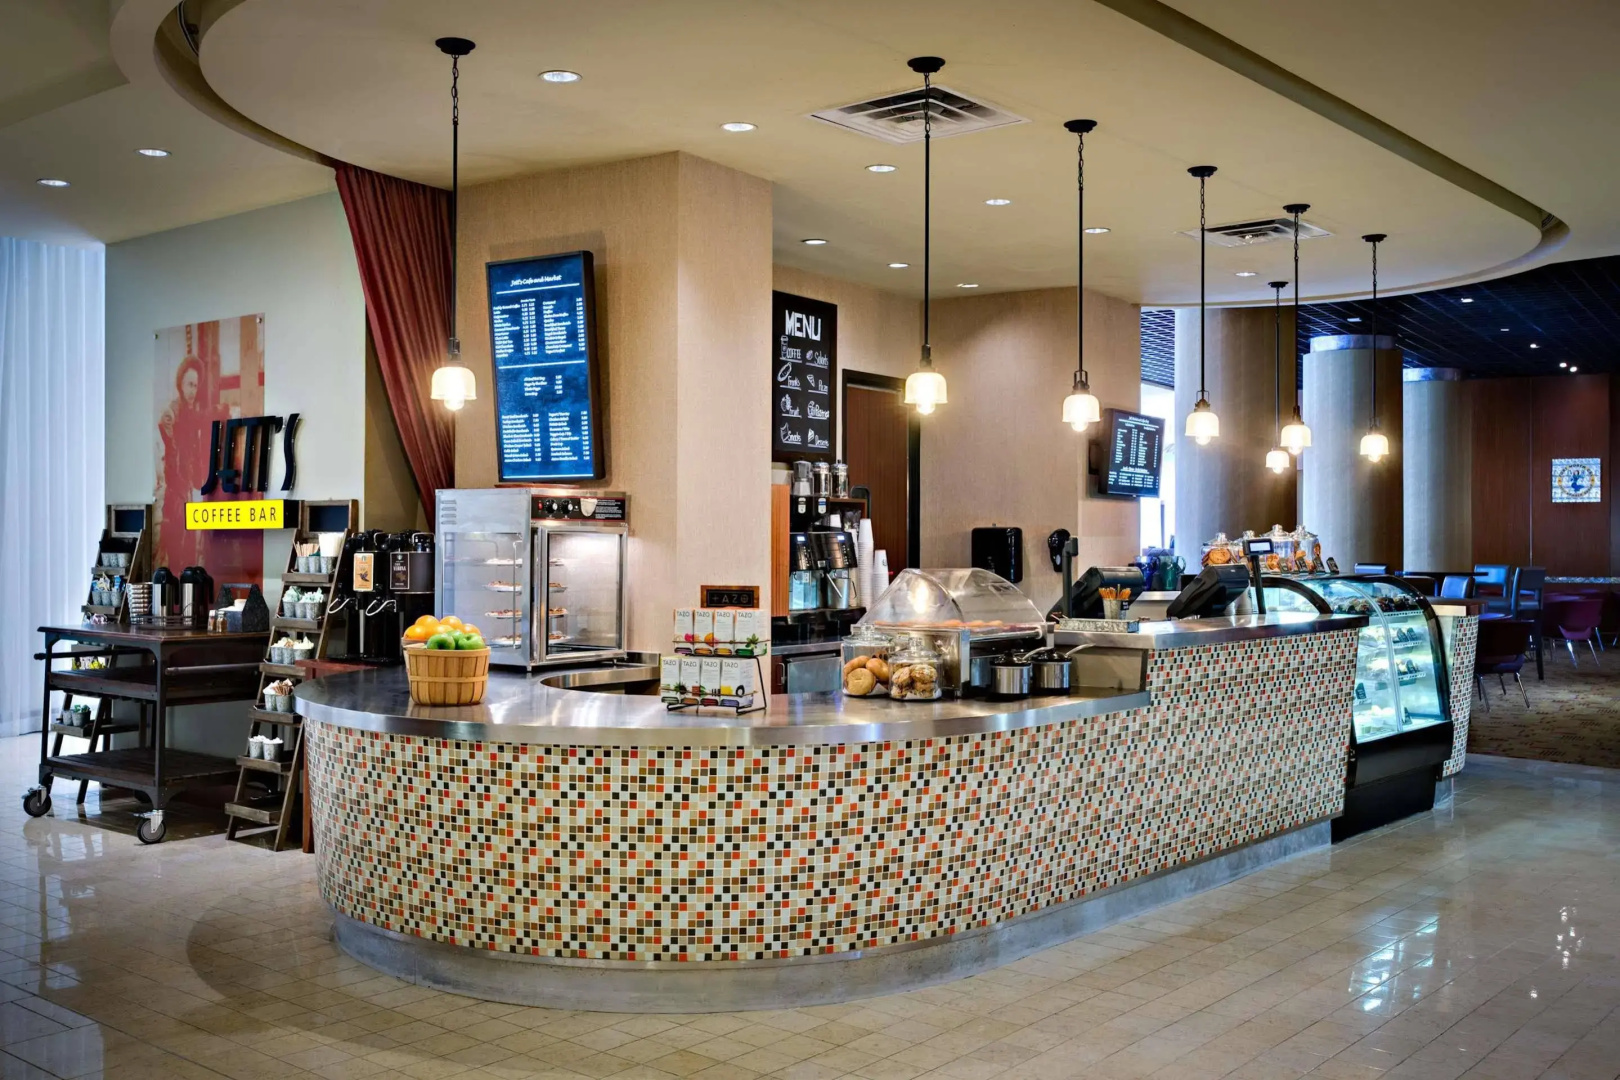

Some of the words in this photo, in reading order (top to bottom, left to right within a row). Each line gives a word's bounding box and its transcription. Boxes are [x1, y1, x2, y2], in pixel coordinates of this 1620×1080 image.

[785, 309, 822, 342] MENU
[193, 508, 241, 523] COFFEE
[249, 507, 277, 522] BAR
